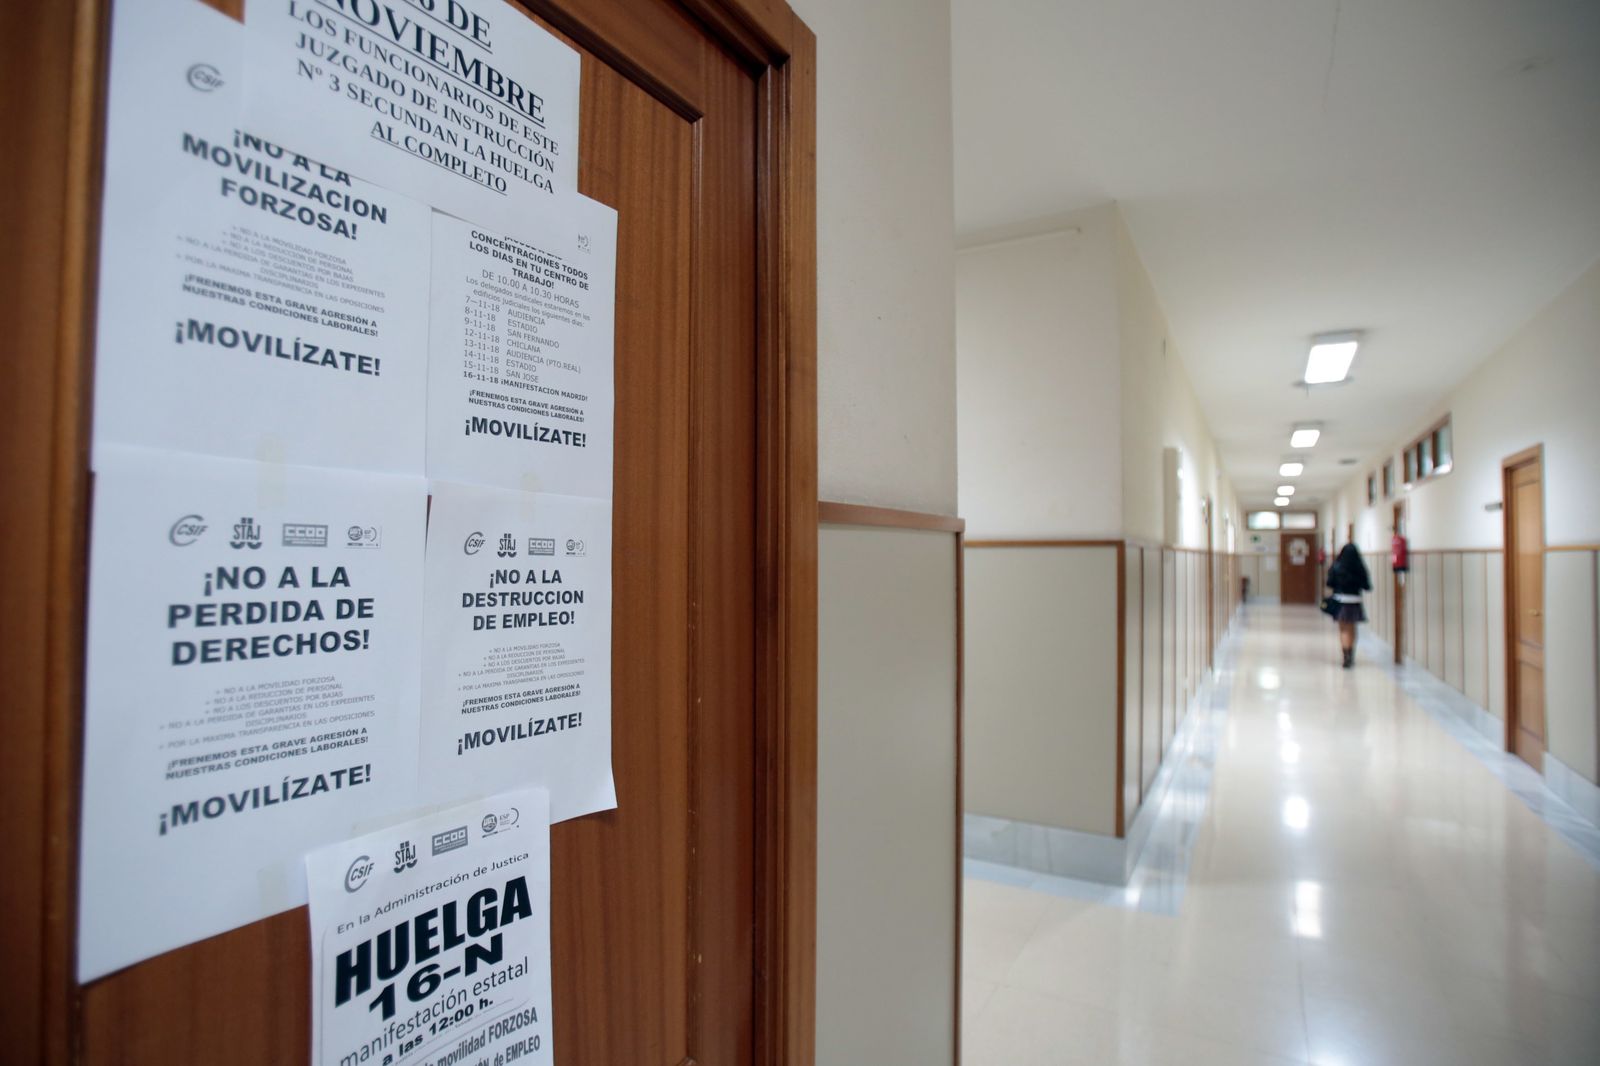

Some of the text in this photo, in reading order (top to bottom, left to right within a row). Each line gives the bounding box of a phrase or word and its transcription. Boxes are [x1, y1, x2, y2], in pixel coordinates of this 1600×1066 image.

[445, 0, 493, 48] DE
[290, 1, 559, 156] LOS FUNCIONARIOS DE ESTE
[296, 34, 554, 173] JUZGADO DE INSTRUCCIÓN
[328, 74, 340, 96] 3
[346, 82, 458, 150] SECUNDAN
[463, 137, 486, 163] LA
[490, 150, 554, 194] HUELGA
[293, 154, 310, 172] A
[320, 164, 351, 186] LA
[370, 120, 506, 193] AL COMPLETO
[182, 132, 387, 224] MOVILIZACION
[220, 177, 357, 240] FORZOSA!
[469, 241, 490, 256] LOS
[492, 249, 514, 265] DIAS
[516, 257, 528, 269] EN
[530, 262, 542, 274] TU
[543, 267, 577, 287] CENTRO
[578, 279, 589, 291] DE
[470, 230, 560, 270] CONCENTRACIONES
[561, 262, 588, 280] TODOS
[466, 275, 478, 287] Los
[480, 279, 512, 298] delegados
[481, 269, 580, 309] DE 10.00 A 10.30 HORAS
[512, 267, 554, 289] TRABAJO!
[182, 283, 378, 337] NUESTRAS CONDICIONES LABORALES!
[254, 291, 282, 306] ESTA
[284, 298, 318, 314] GRAVE
[370, 318, 378, 328] A
[465, 307, 538, 333] 8-11-18 ESTADIO
[508, 309, 545, 325] AUDIENCIA
[175, 318, 381, 376] ¡MOVILÍZATE!
[465, 318, 560, 349] 9-11-18 SAN FERNANDO
[465, 329, 541, 353] 12-11-18 CHICLANA
[464, 350, 537, 373] 14-11-18 ESTADIO
[465, 339, 500, 353] 13-11-18
[507, 350, 544, 364] AUDIENCIA
[463, 371, 499, 384] 16-11-18
[561, 391, 588, 402] MADRID!
[464, 360, 539, 383] 15-11-18 SAN JOSE
[468, 397, 505, 410] NUESTRAS
[506, 404, 550, 417] CONDICIONES
[510, 396, 526, 406] ESTA
[527, 400, 549, 410] GRAVE
[465, 416, 587, 447] ¡MOVILÍZATE!
[204, 566, 351, 597] ¡NO A LA
[490, 569, 562, 588] ¡NO A LA
[168, 598, 375, 629] PERDIDA DE
[462, 590, 584, 608] DESTRUCCION
[473, 611, 575, 631] DE EMPLEO!
[172, 629, 369, 666] DERECHOS!
[461, 703, 499, 714] NUESTRAS
[500, 696, 544, 708] CONDICIONES
[504, 692, 521, 700] ESTA
[522, 689, 544, 698] GRAVE
[240, 743, 268, 757] ESTA
[272, 737, 306, 751] GRAVE
[360, 727, 368, 735] A
[458, 712, 582, 755] ¡MOVILÍZATE!
[165, 736, 369, 780] NUESTRAS CONDICIONES LABORALES!
[159, 764, 372, 836] ¡MOVILÍZATE!
[395, 845, 416, 866] STAJ
[337, 922, 354, 934] En
[360, 914, 370, 923] la
[374, 872, 469, 917] Administración
[473, 866, 487, 877] de
[335, 876, 532, 1008] HUELGA
[369, 933, 503, 1022] 16-N
[340, 956, 528, 1066] manifestación estatal
[382, 1054, 393, 1065] a
[399, 1034, 423, 1057] las
[429, 1005, 474, 1036] 12:00
[479, 997, 493, 1010] h.
[438, 1030, 486, 1066] movilidad
[489, 1007, 537, 1042] FORZOSA
[494, 1052, 504, 1065] de
[506, 1035, 540, 1063] EMPLEO
